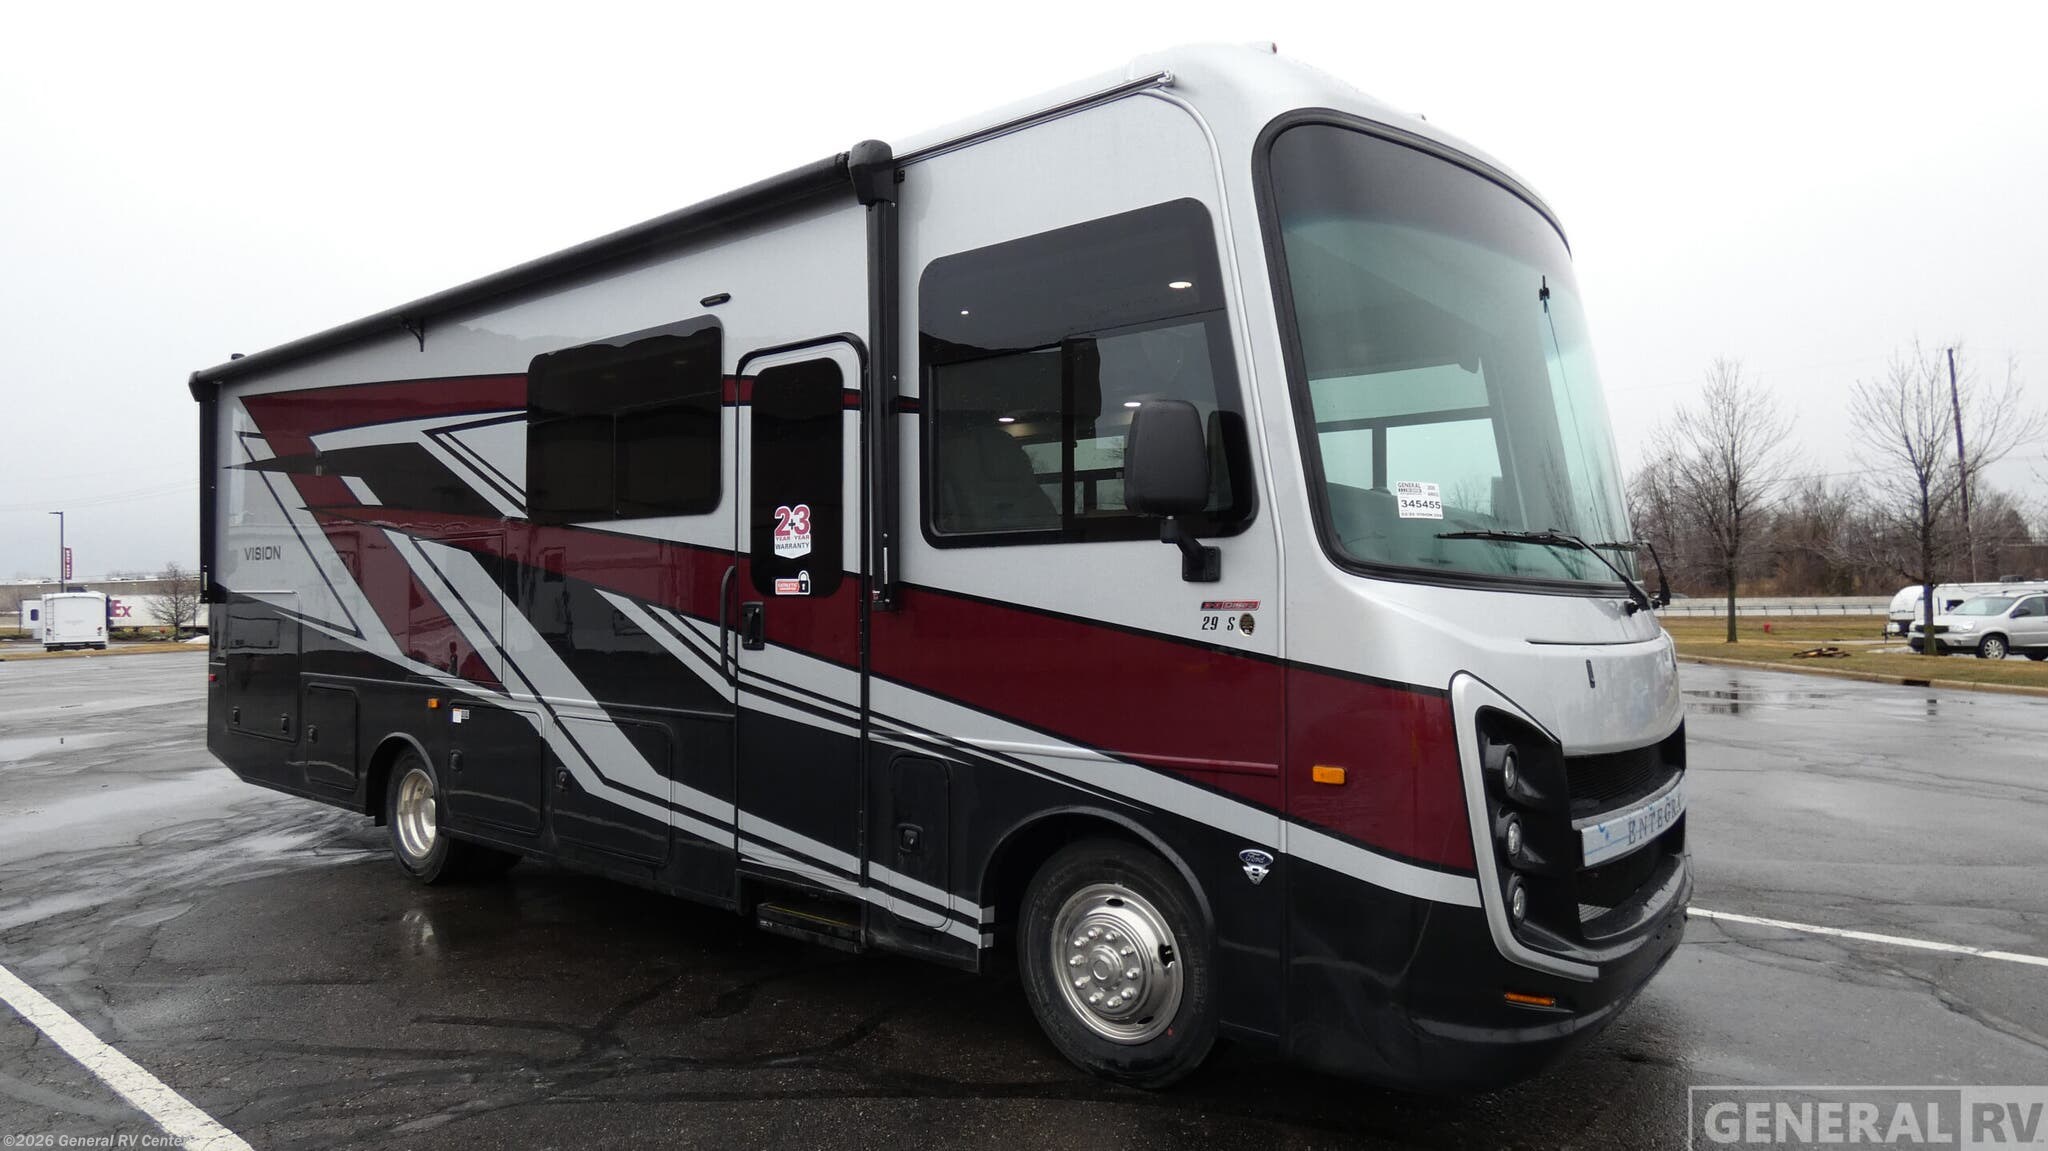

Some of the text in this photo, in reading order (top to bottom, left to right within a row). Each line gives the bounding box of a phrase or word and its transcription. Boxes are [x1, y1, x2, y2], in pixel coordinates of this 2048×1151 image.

[1401, 499, 1441, 509] 345455
[775, 542, 810, 550] WARRANTY
[244, 545, 281, 561] VISION
[1201, 616, 1236, 631] 29 S
[1245, 851, 1267, 864] Ford
